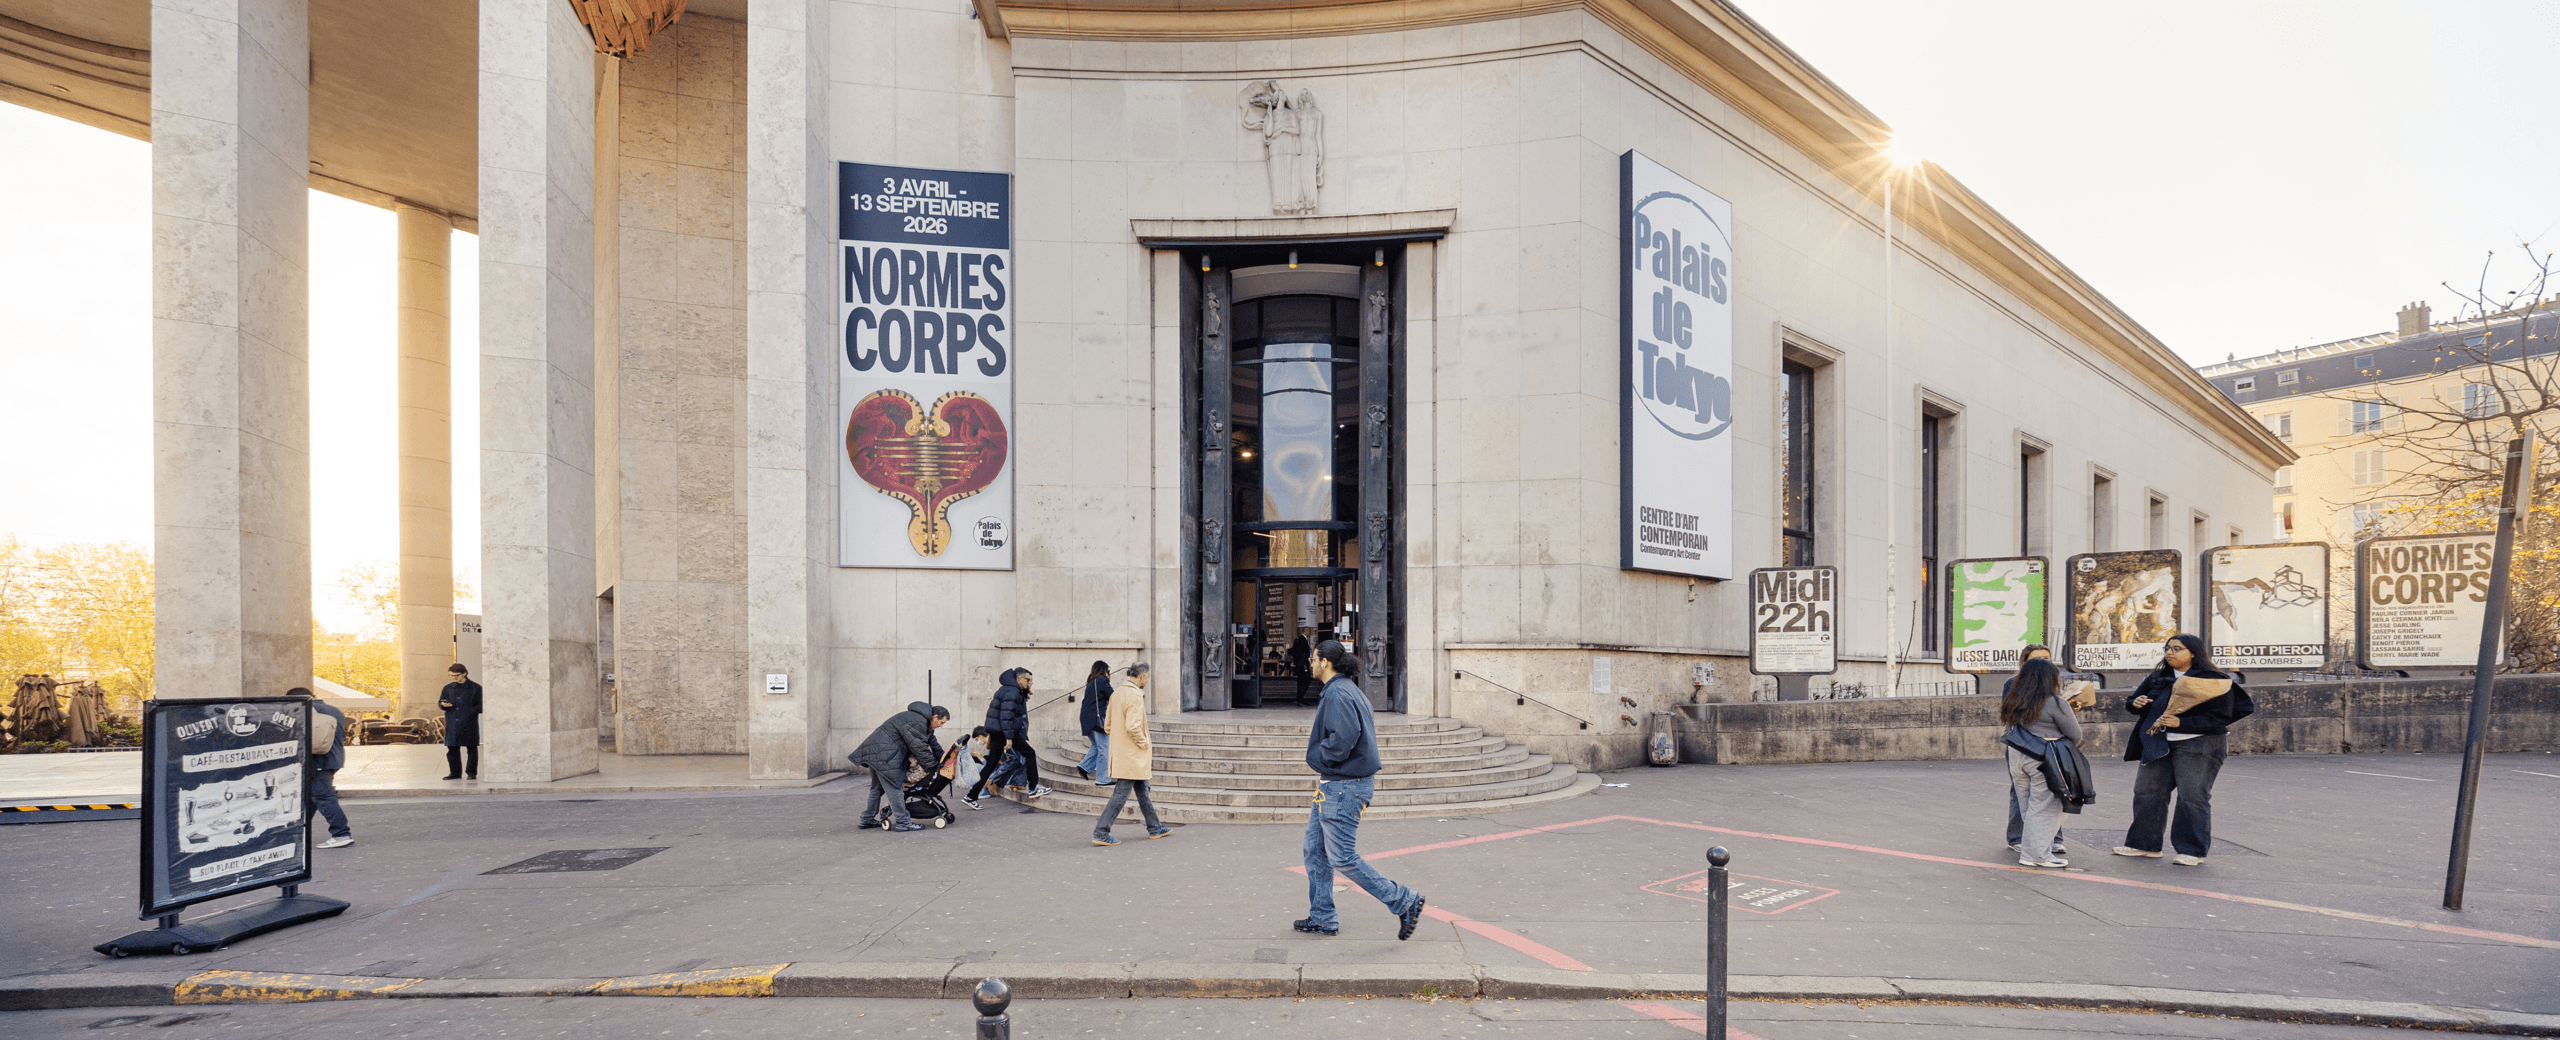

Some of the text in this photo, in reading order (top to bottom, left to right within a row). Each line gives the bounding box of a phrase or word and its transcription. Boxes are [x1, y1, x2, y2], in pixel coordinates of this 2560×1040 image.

[884, 178, 895, 194] 3
[899, 178, 957, 198] AVRIL
[850, 193, 1000, 219] 13 SEPTEMBRE
[904, 216, 948, 234] 2026
[1635, 212, 1727, 305] Palais
[845, 246, 1006, 311] NORMES
[1653, 286, 1692, 350] de
[846, 306, 1006, 377] CORPS
[1638, 338, 1731, 424] Tokyo
[978, 520, 1001, 530] Palais
[1640, 506, 1699, 531] CENTRE D'ART
[980, 537, 1003, 547] Tokyo
[1640, 525, 1708, 551] CONTEMPORAIN
[1640, 543, 1676, 558] Contemporary
[1685, 550, 1701, 560] Center
[2372, 542, 2492, 574] NORMES
[1757, 570, 1830, 603] Midi
[2372, 571, 2490, 605] CORPS
[1758, 602, 1830, 633] 22h
[1956, 650, 2020, 662] JESSE DARL
[176, 717, 219, 738] OUVERT
[272, 712, 296, 728] OPEN
[200, 866, 214, 877] SUR
[217, 861, 239, 872] PLACE
[249, 854, 266, 864] TAKE
[268, 849, 288, 859] AWAY
